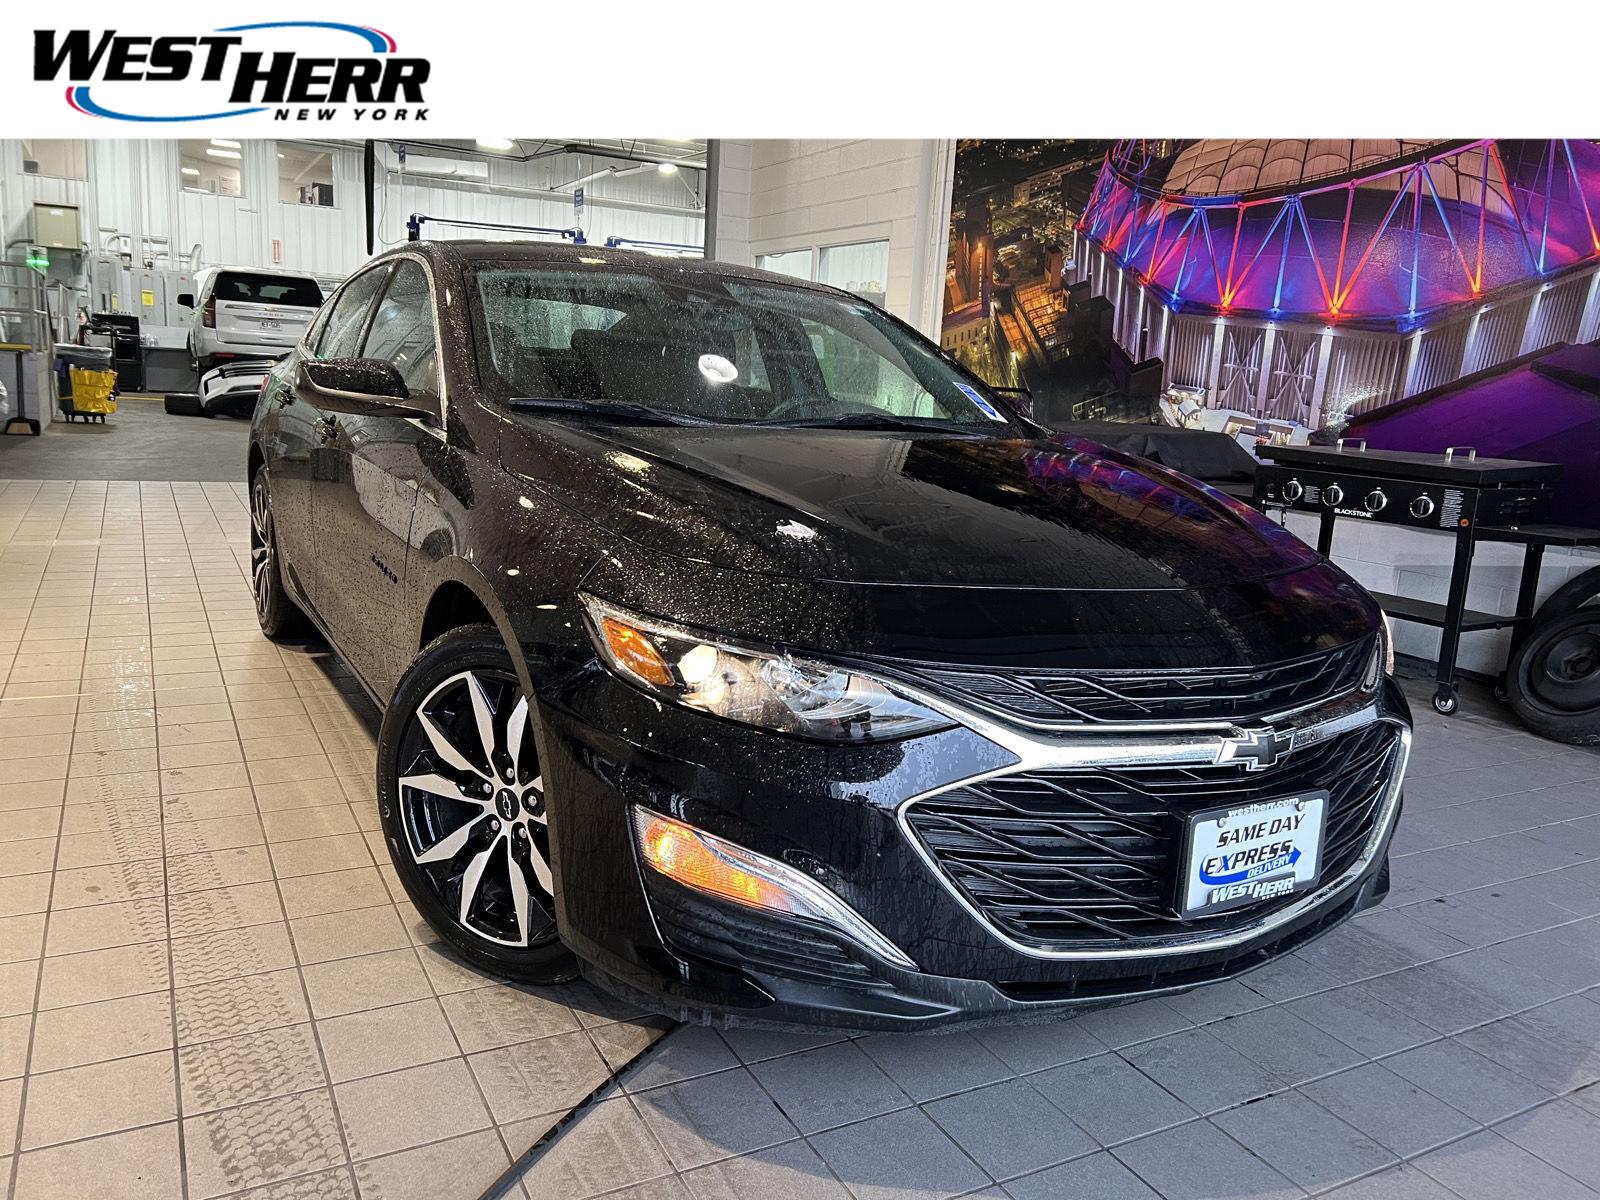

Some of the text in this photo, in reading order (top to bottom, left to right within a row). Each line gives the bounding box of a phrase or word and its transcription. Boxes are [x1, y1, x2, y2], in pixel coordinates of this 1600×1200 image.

[1334, 508, 1373, 518] BLACKSTONE
[1228, 798, 1299, 817] westherr.com
[1216, 813, 1306, 848] SAME DAY
[1204, 840, 1293, 875] EXPRESS
[1246, 854, 1292, 879] DELIVERY
